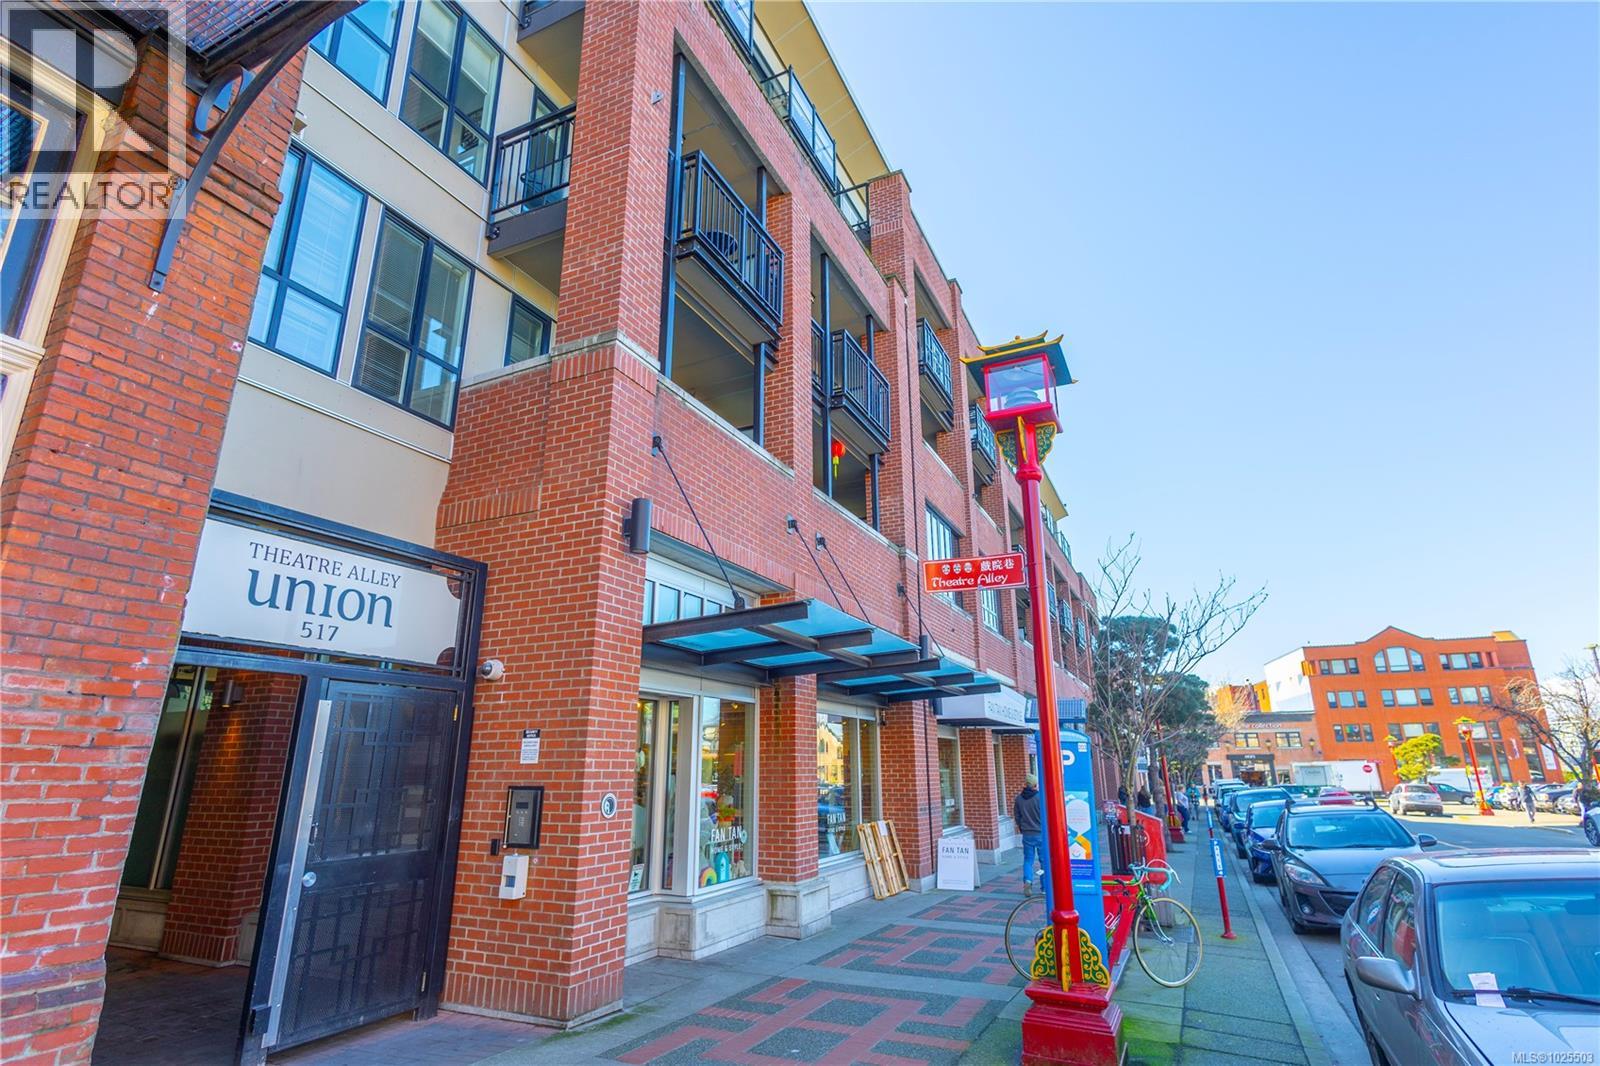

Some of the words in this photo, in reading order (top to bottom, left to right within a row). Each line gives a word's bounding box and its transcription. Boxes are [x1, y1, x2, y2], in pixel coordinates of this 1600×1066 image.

[250, 541, 343, 577] THEATRE
[347, 565, 402, 589] ALLEY
[931, 576, 975, 588] Theatre
[977, 573, 1009, 585] Alley
[247, 568, 393, 628] union
[300, 621, 339, 641] 517
[827, 814, 836, 825] FAN
[837, 812, 846, 822] TAN
[711, 828, 726, 842] FAN
[728, 825, 742, 840] TAN
[942, 846, 955, 854] FAN
[956, 846, 970, 855] TAN
